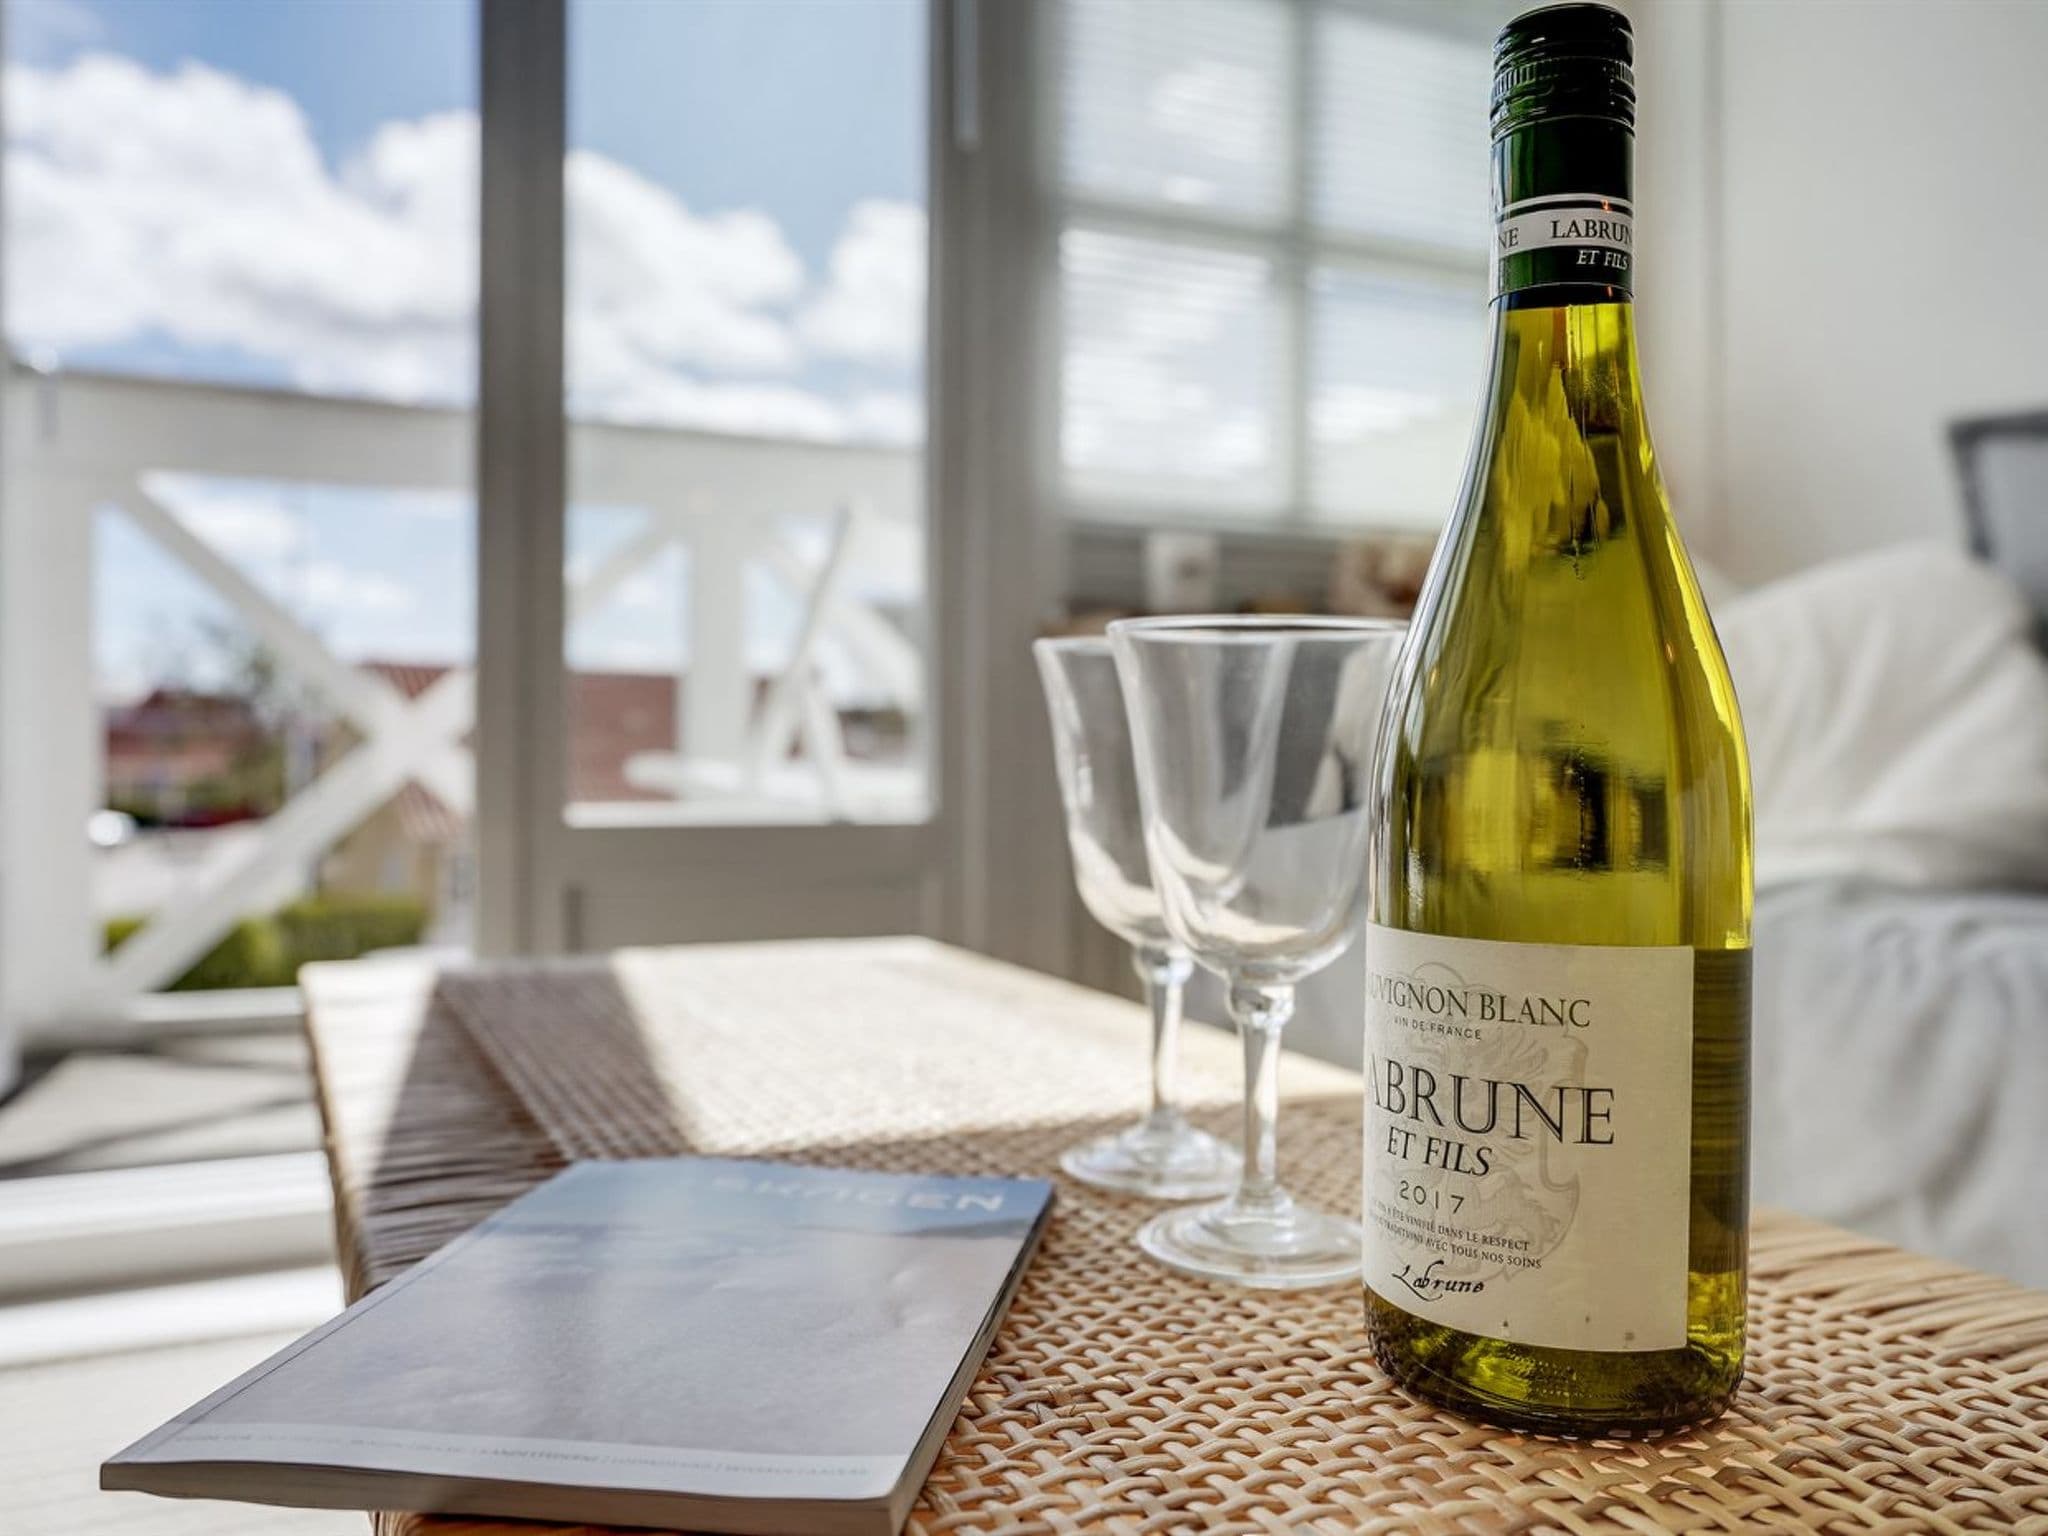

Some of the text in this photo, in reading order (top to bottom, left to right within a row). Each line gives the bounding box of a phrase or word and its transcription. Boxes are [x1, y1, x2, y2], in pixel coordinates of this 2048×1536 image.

[1576, 249, 1629, 271] ET FILS
[1479, 992, 1591, 1028] BLANC
[1412, 1019, 1426, 1032] DE
[1430, 1022, 1482, 1041] FRANCE
[1387, 1126, 1493, 1178] ET FILS
[1399, 1180, 1465, 1215] 2017
[1438, 1225, 1464, 1240] DANS
[1466, 1231, 1479, 1243] LE
[1481, 1235, 1531, 1252] RESPECT
[1450, 1243, 1478, 1259] TOUS
[1481, 1250, 1504, 1265] NOS
[1506, 1255, 1543, 1270] SOINS
[1391, 1259, 1485, 1302] Labrune
